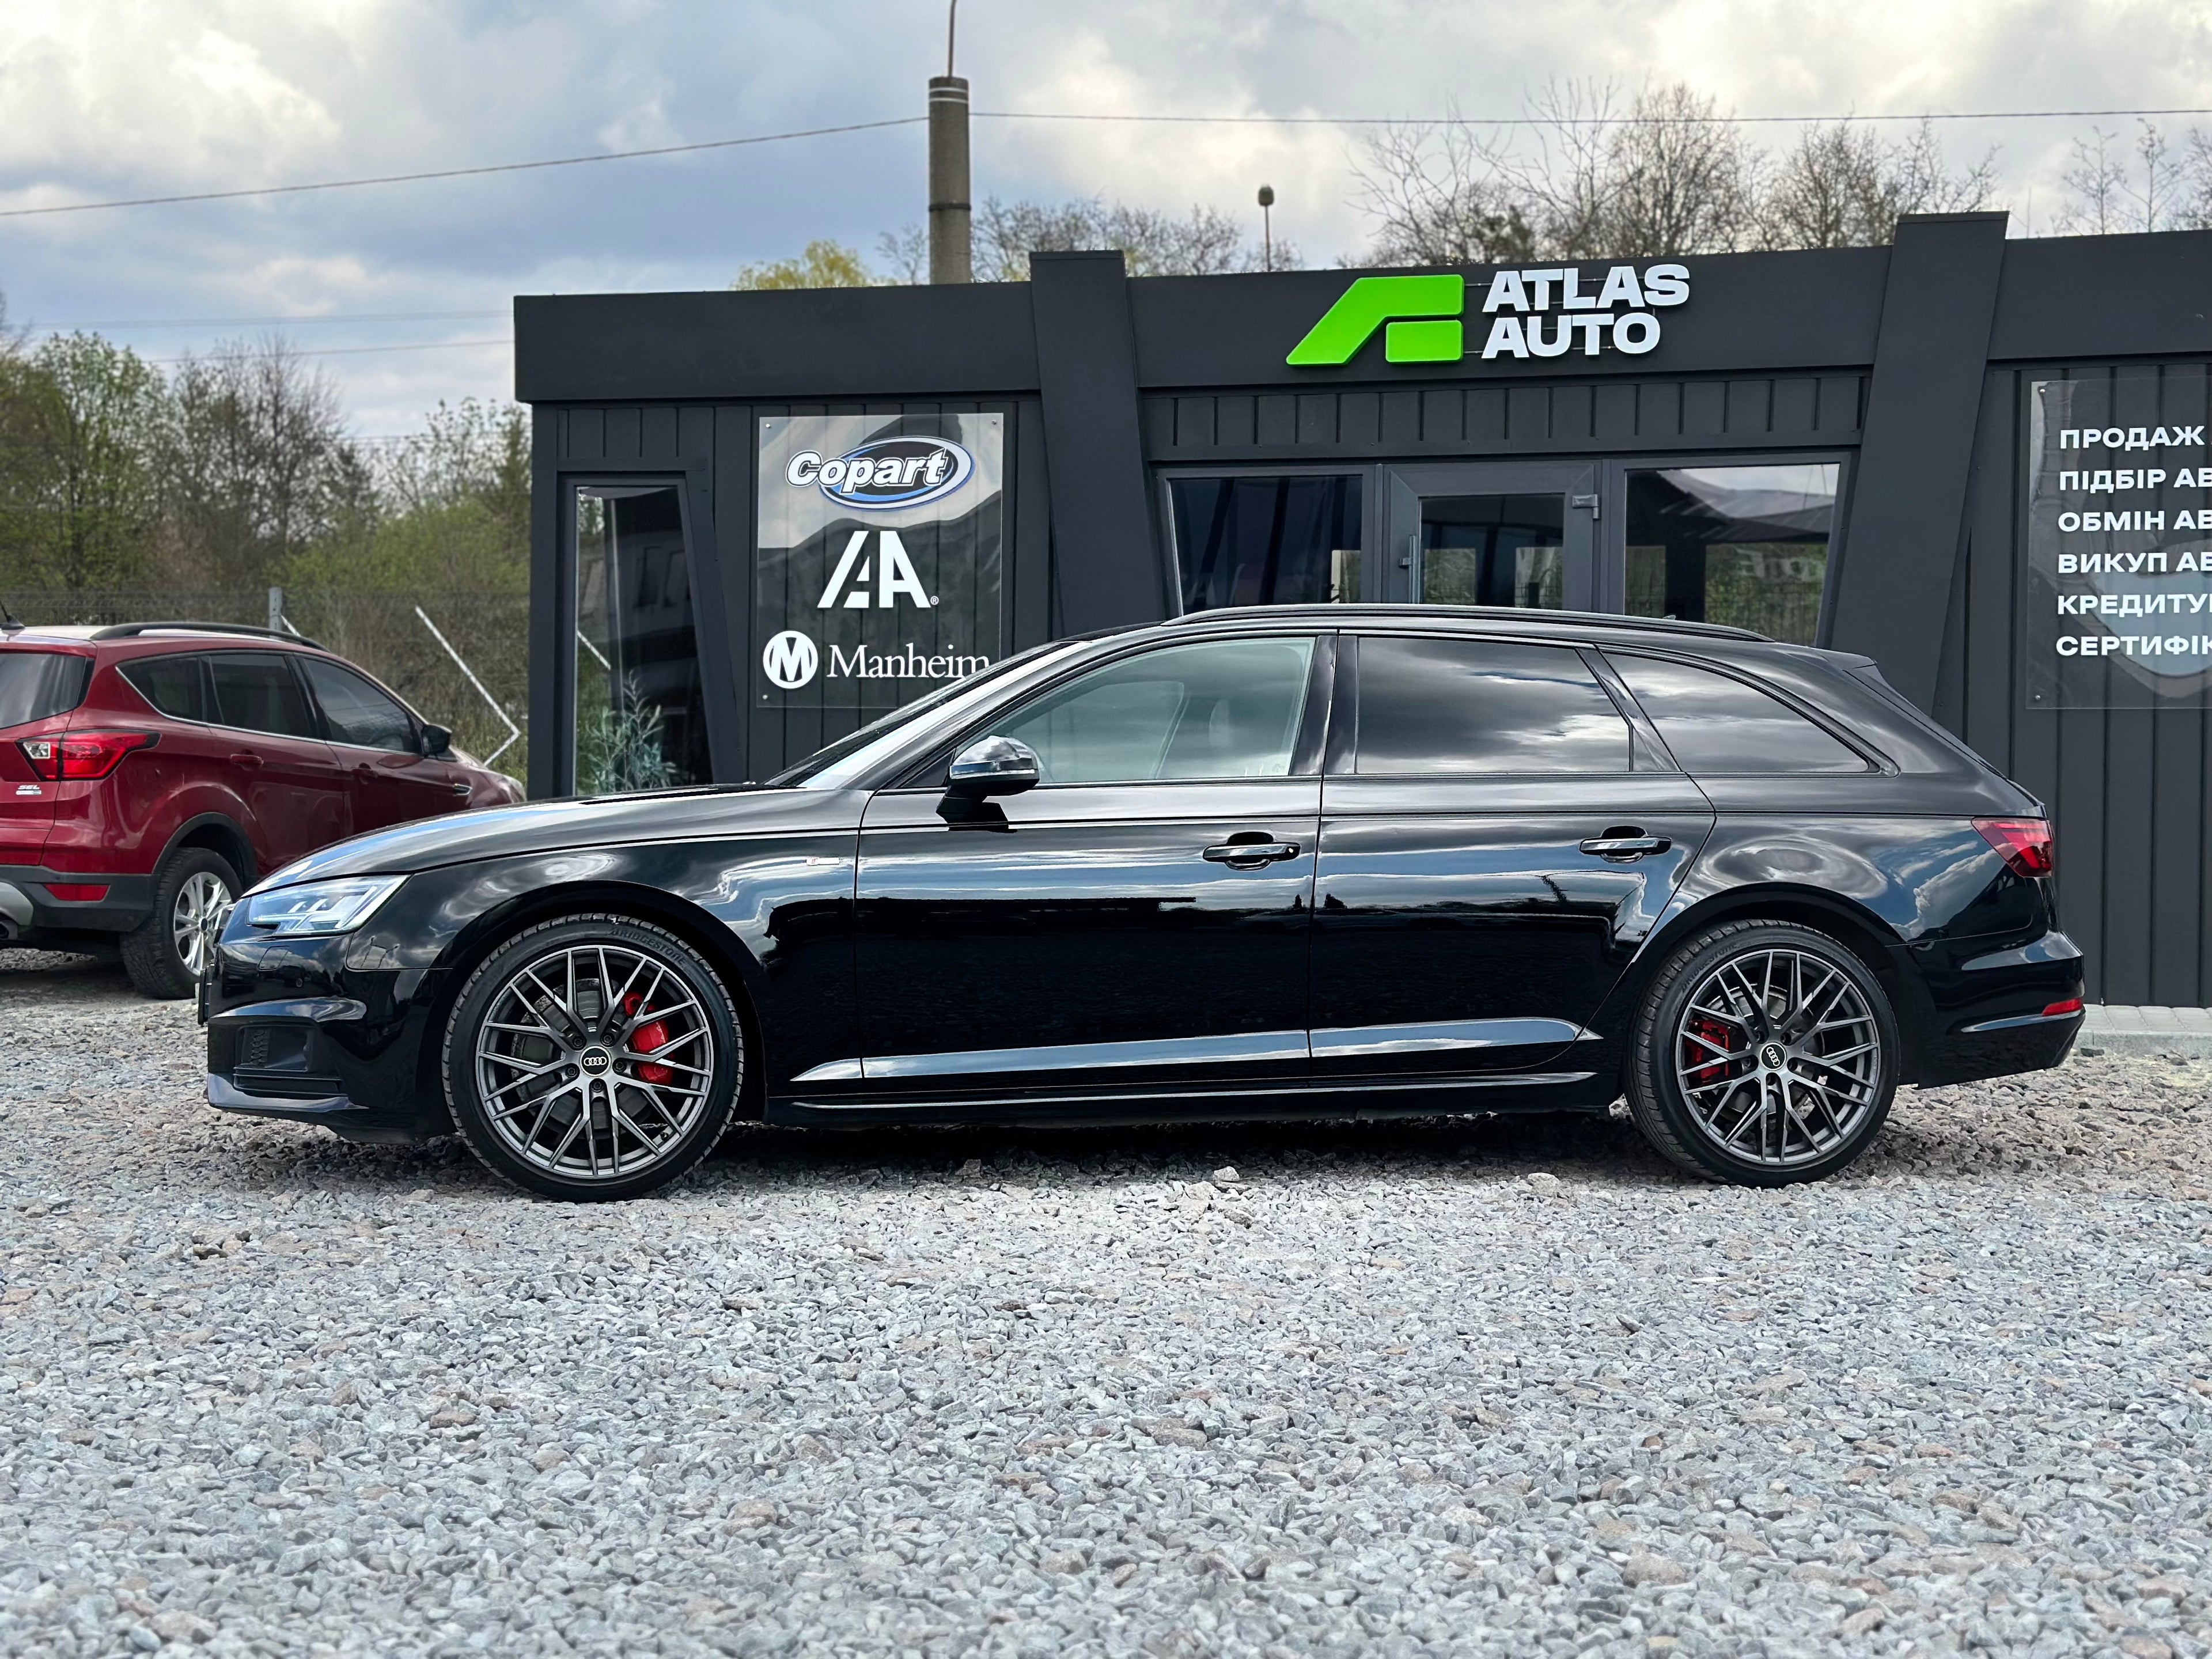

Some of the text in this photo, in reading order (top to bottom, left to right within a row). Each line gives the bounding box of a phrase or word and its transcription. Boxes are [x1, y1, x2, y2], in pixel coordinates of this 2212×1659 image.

[1482, 263, 1690, 313] ATLAS
[1480, 312, 1661, 359] AUTO
[2059, 426, 2206, 451] ПРОДАЖ
[785, 449, 948, 495] Copart
[2059, 468, 2167, 494] ПІДБІР
[2058, 510, 2165, 532] ОБМІН
[2058, 552, 2168, 574] ВИКУП
[2057, 593, 2212, 618] КРЕДИТУ
[826, 642, 990, 679] Manheim
